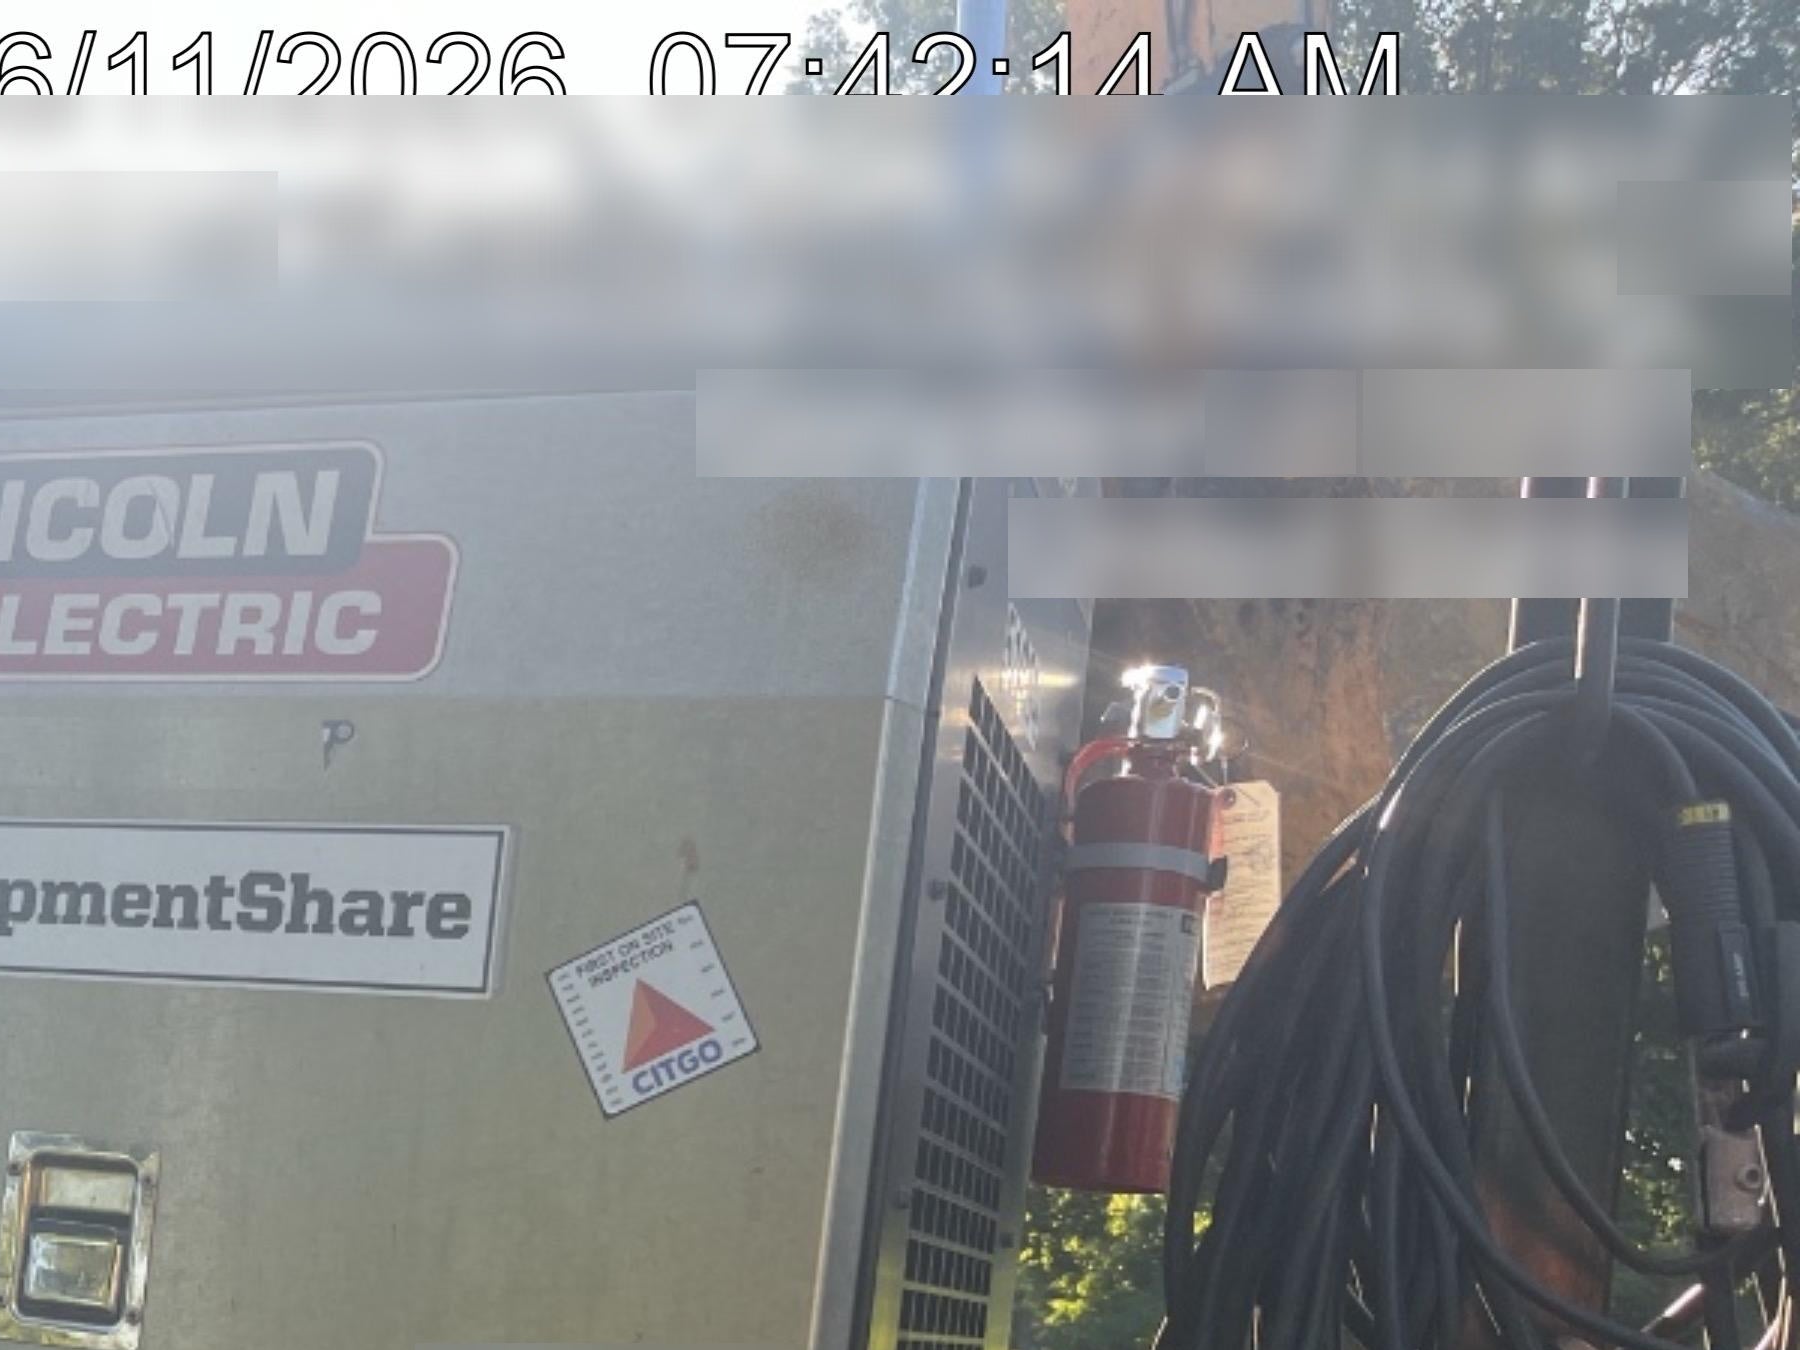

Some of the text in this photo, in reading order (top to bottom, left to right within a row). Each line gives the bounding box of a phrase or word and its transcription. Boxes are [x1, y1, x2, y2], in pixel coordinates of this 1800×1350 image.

[587, 940, 674, 988] INSPECTION
[618, 938, 640, 958] ON
[631, 1038, 723, 1095] CITGO
